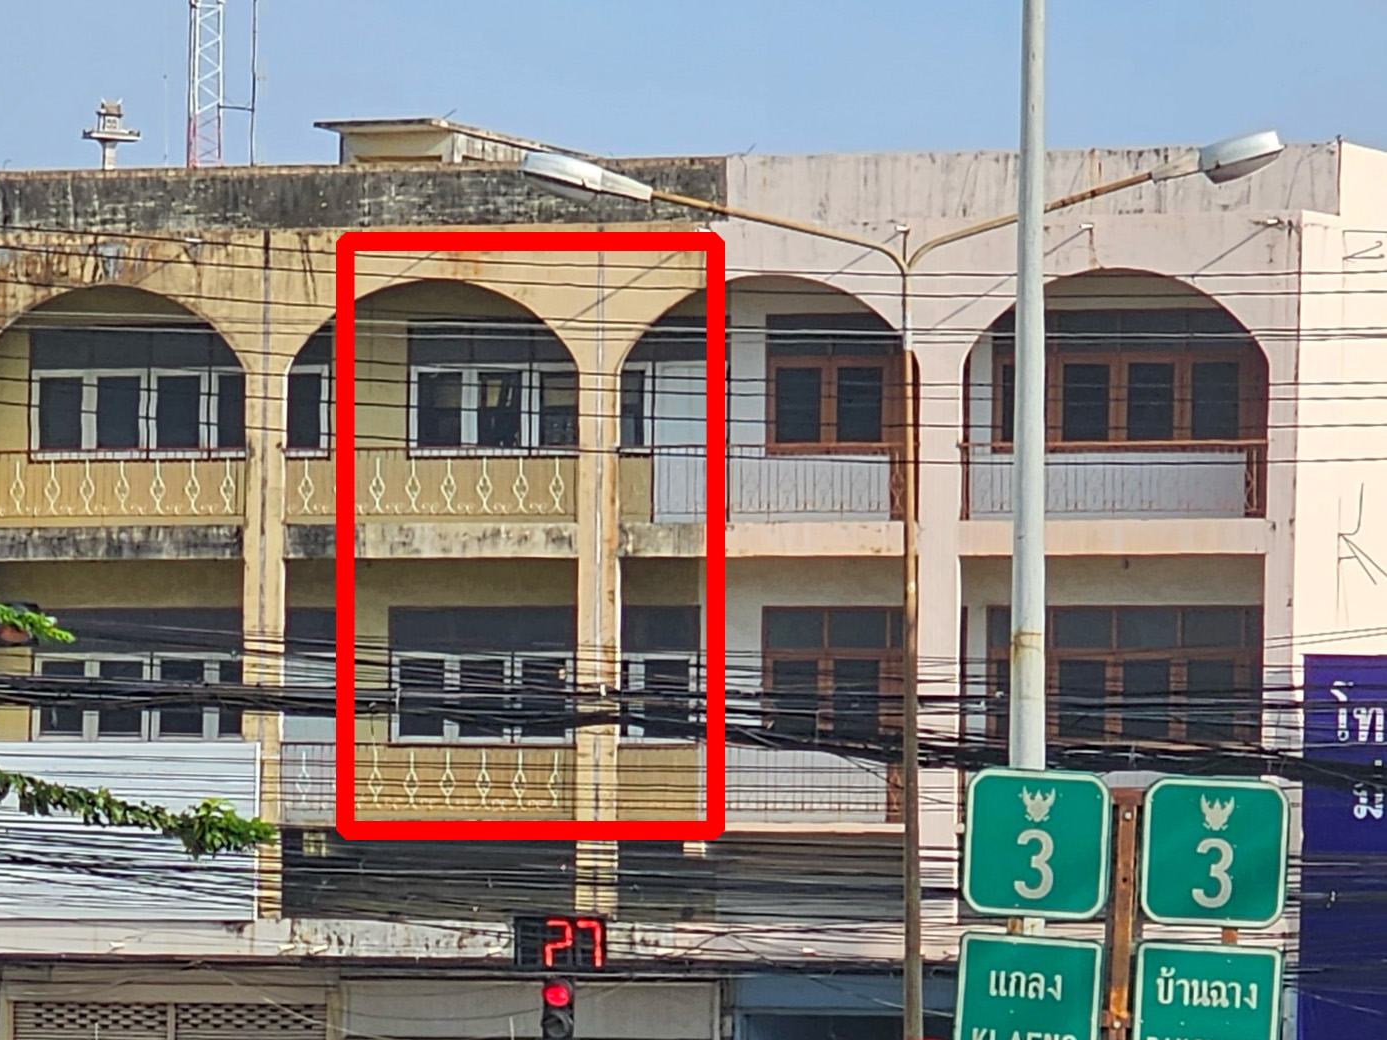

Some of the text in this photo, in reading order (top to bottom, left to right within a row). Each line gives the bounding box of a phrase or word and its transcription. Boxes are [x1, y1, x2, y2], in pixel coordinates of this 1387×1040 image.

[1013, 829, 1054, 900] 3
[1191, 838, 1234, 909] 3
[543, 919, 602, 968] 27
[988, 969, 1062, 1002] แกลง
[1156, 966, 1259, 1010] บ้านฉาง
